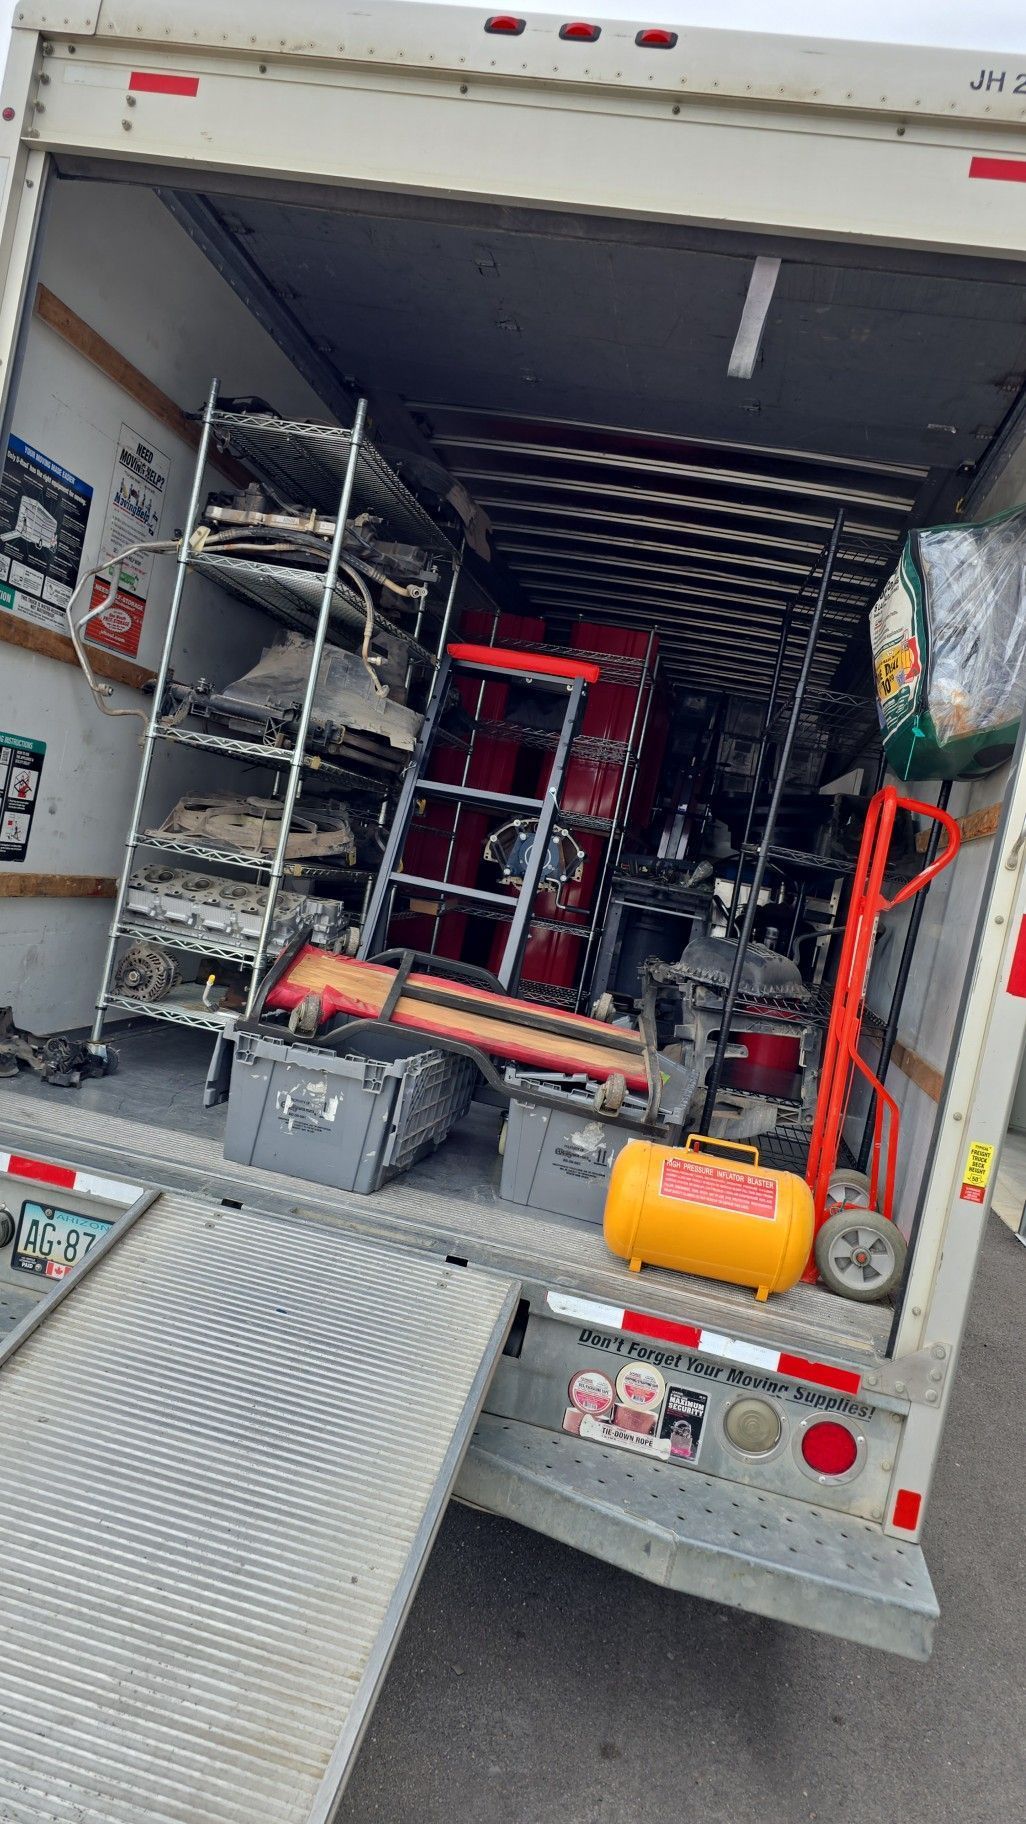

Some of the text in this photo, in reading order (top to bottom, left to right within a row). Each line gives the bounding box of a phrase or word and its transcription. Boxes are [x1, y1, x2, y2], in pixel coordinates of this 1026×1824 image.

[970, 69, 1006, 92] JH
[136, 443, 153, 464] NEED
[120, 449, 147, 476] MOVING
[145, 465, 165, 490] HELP?
[0, 590, 11, 604] ION
[115, 594, 144, 610] LF-STORAGE
[971, 1149, 991, 1158] FREIGHT
[972, 1155, 988, 1163] TRUCK
[666, 1159, 774, 1189] HIGH PRESSURE INFLATOR BLASTER
[969, 1167, 986, 1175] HEIGHT
[56, 1214, 113, 1233] ARIZON
[579, 1328, 876, 1420] Don't Forget Your Moving Supplies!
[668, 1402, 704, 1417] SECURITY
[669, 1396, 705, 1411] MAXIMUM
[601, 1426, 635, 1442] TIE-DOWN
[636, 1437, 654, 1447] ROPE
